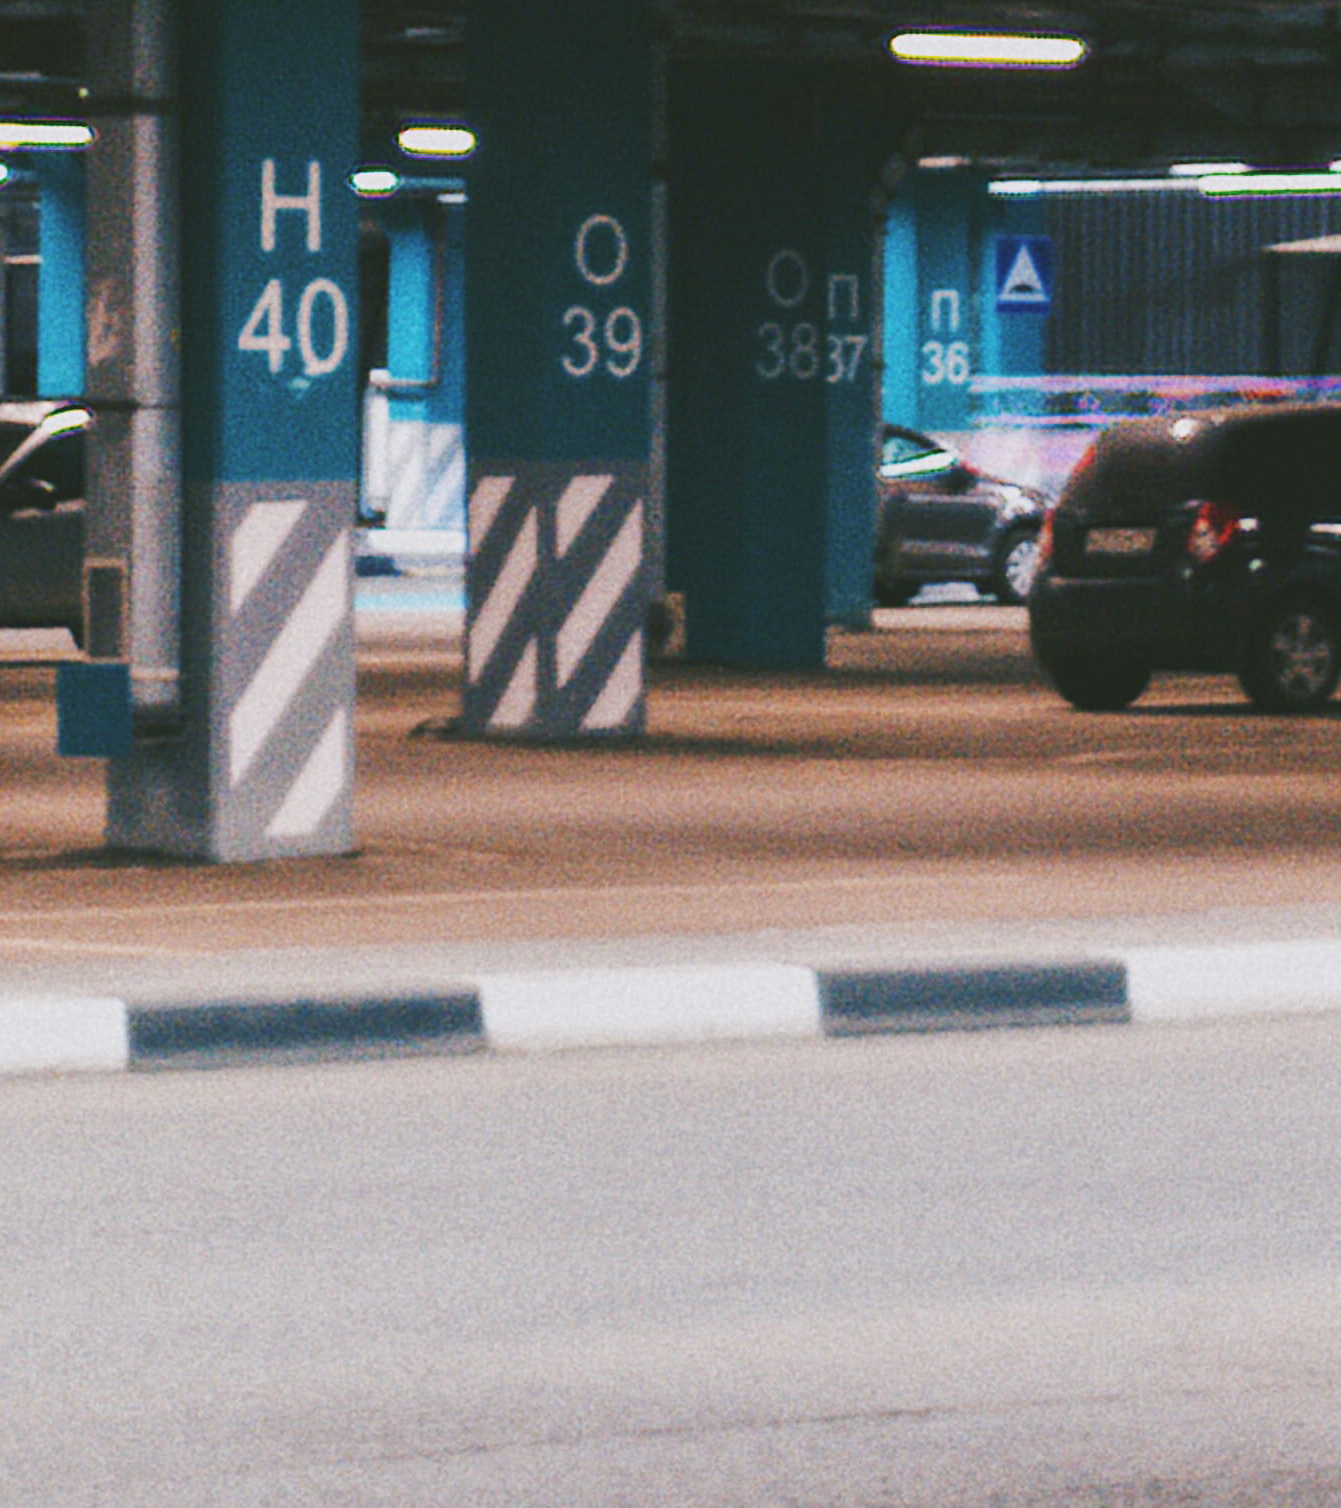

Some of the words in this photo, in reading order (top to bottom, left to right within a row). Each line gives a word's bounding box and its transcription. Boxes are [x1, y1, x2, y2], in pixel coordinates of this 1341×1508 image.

[237, 278, 348, 376] 40
[563, 307, 642, 378] 39
[757, 322, 819, 380] 38
[827, 335, 868, 383] 37
[922, 340, 970, 384] 36
